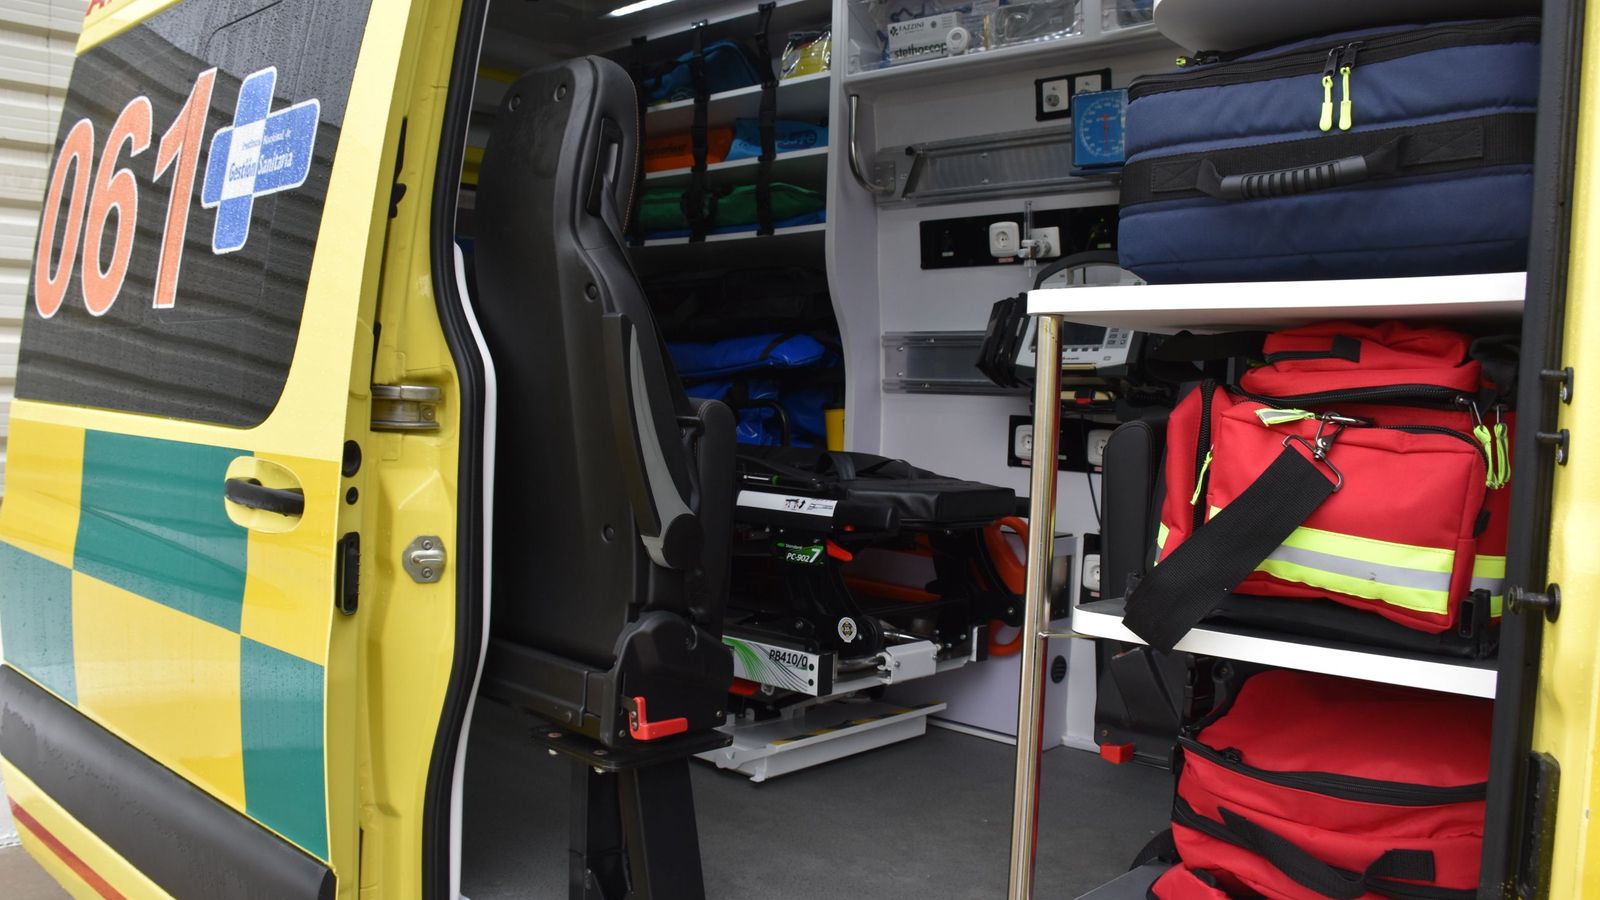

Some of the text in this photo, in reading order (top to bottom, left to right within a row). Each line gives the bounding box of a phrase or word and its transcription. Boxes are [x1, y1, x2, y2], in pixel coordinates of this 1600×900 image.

[895, 42, 948, 58] stethoscop
[229, 147, 293, 182] Gestión Sanitaria
[35, 66, 217, 319] 061
